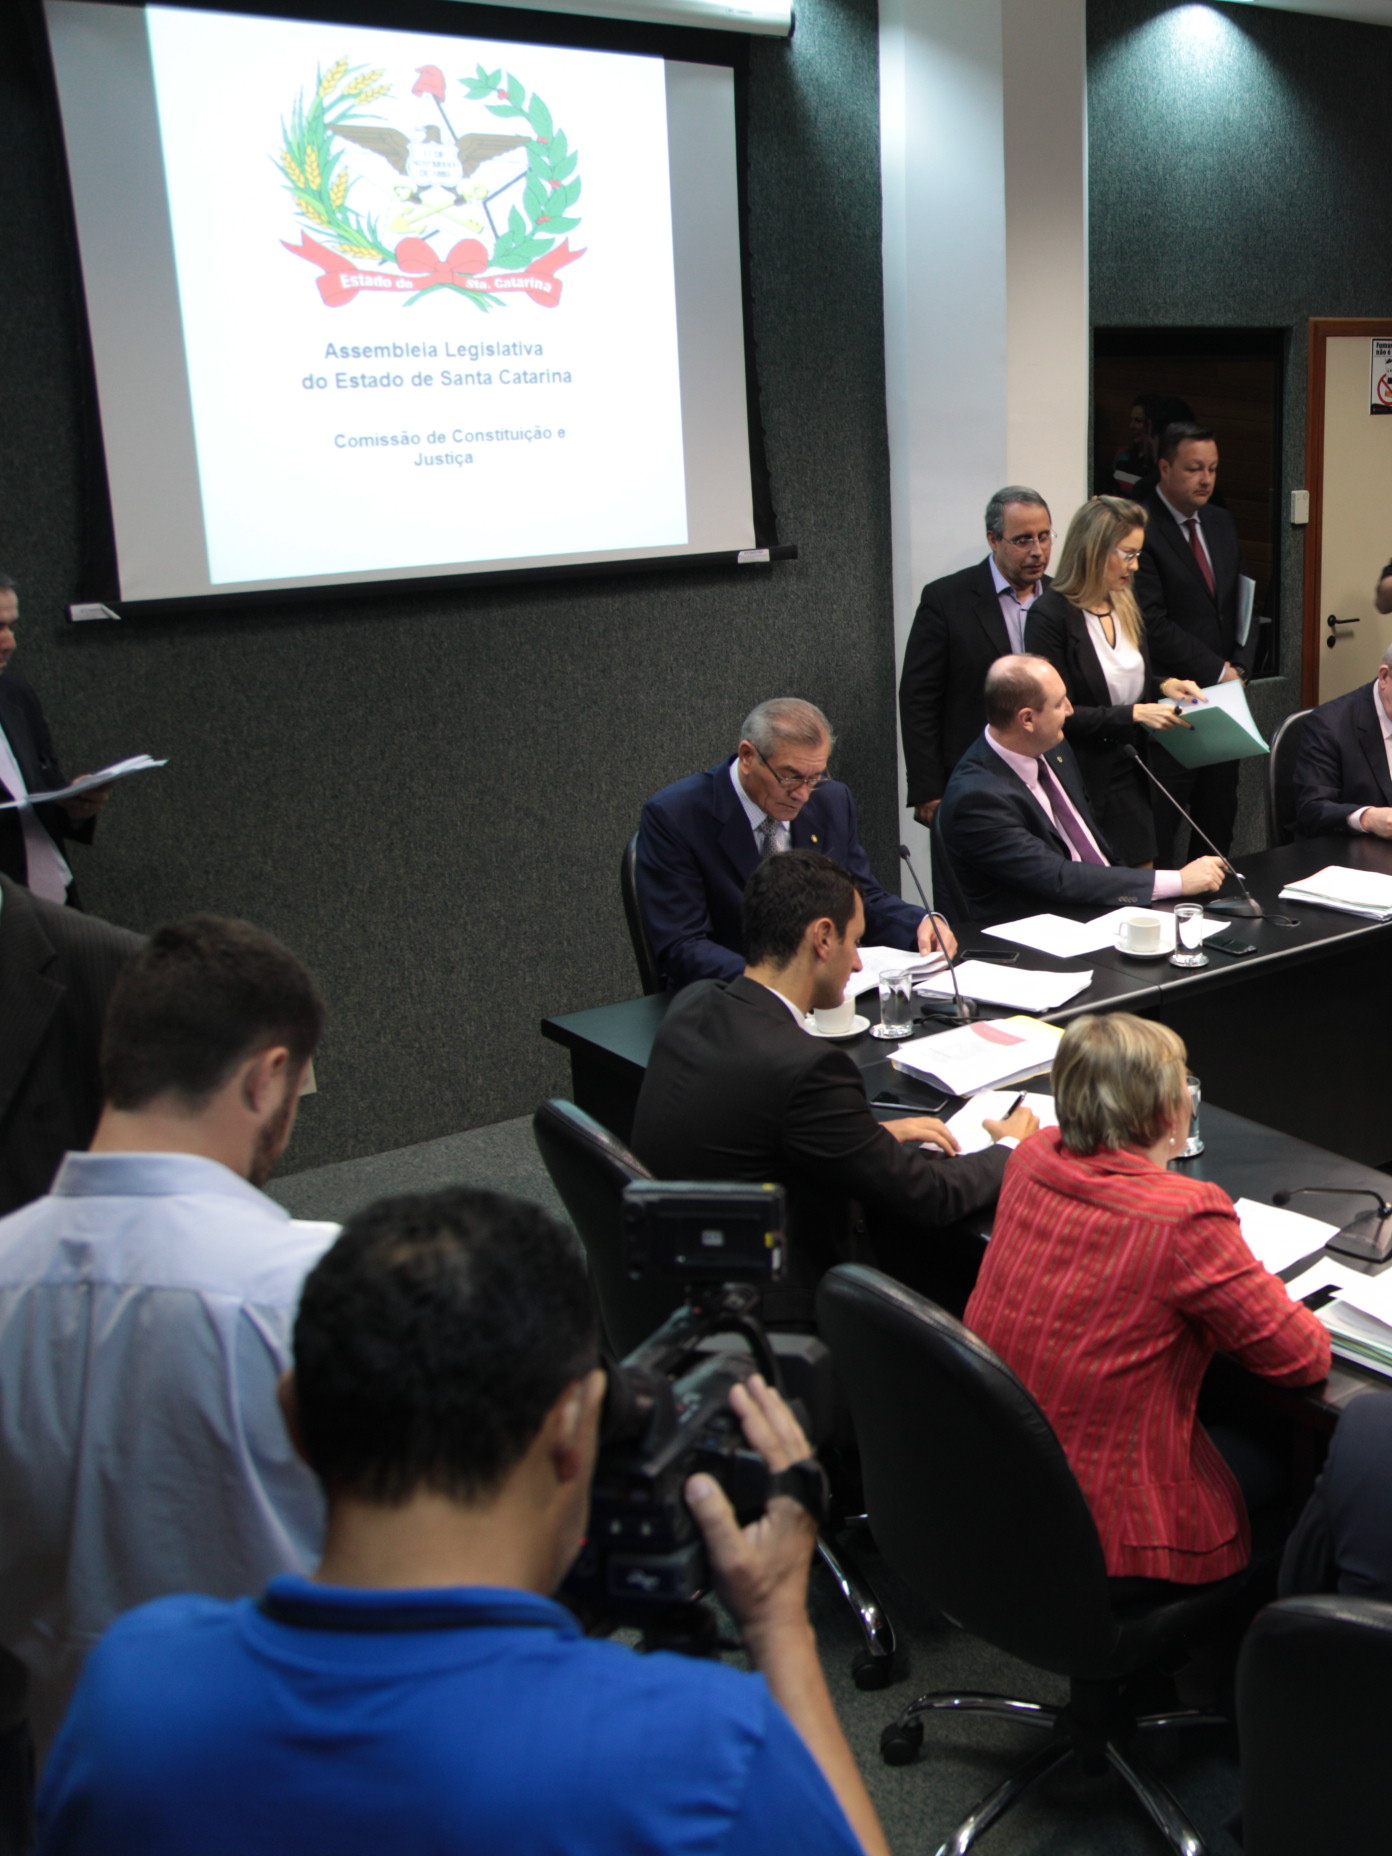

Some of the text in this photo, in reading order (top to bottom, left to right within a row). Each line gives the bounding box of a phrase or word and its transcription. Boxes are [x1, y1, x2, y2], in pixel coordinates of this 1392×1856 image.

[340, 273, 392, 289] Estado
[466, 279, 491, 289] Sta.
[494, 276, 552, 293] Catarina
[324, 341, 543, 361] Assembleia Legislativa
[302, 368, 572, 390] do Estado de Santa Catarina
[334, 425, 566, 448] Comissão de Constituição e
[414, 451, 473, 468] Justiça
